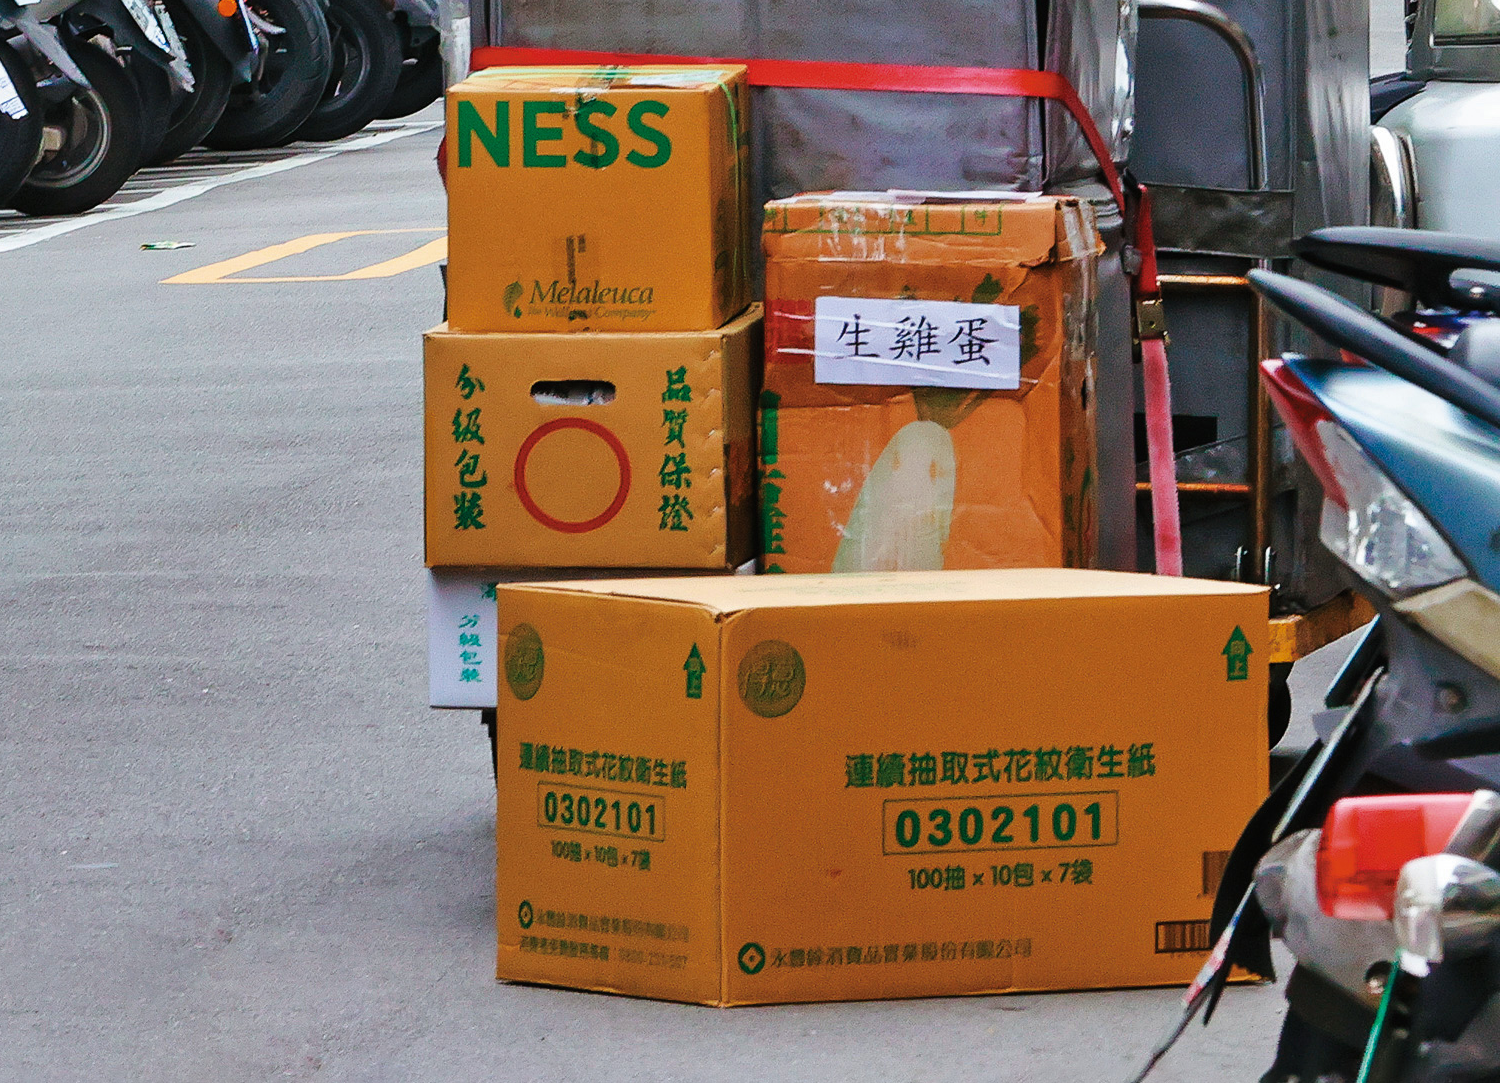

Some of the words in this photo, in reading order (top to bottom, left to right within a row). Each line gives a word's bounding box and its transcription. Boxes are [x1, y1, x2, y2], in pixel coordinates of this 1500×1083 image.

[457, 99, 672, 169] NESS
[528, 279, 654, 305] Melaleuca
[837, 313, 999, 366] 生雞蛋
[451, 363, 488, 531] 分級包裝
[844, 742, 1157, 788] 連續抽取式花紋衛生紙
[544, 790, 656, 835] 0302101
[895, 802, 1102, 848] 0302101
